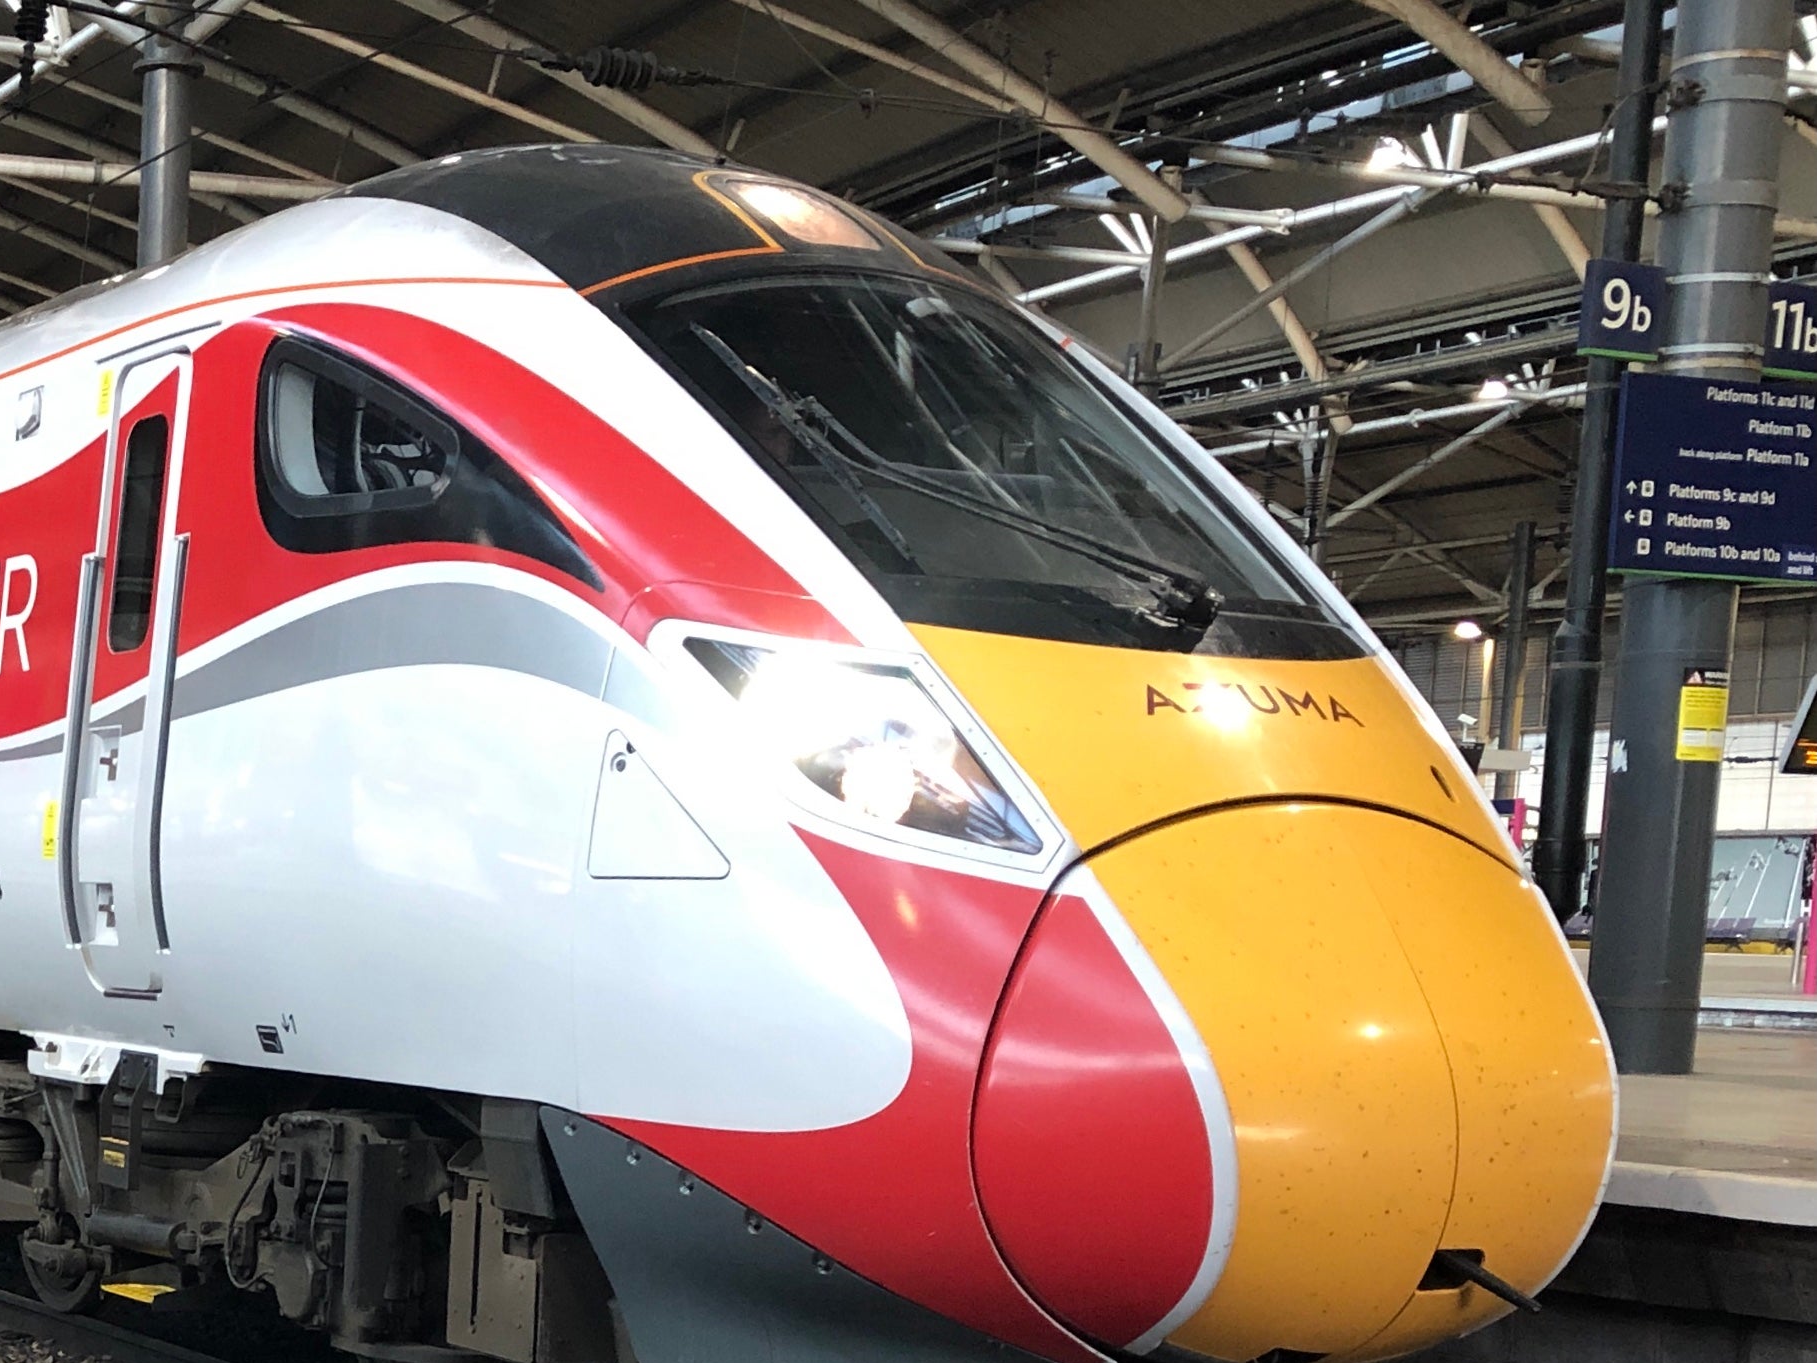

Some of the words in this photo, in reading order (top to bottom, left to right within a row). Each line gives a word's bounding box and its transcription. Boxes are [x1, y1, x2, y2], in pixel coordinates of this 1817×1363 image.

[1601, 277, 1652, 333] 9b
[1772, 299, 1817, 354] 11b
[1706, 386, 1759, 405] Platforms
[1761, 391, 1776, 406] 11c
[1777, 395, 1798, 408] and
[1799, 395, 1816, 410] 11d
[1748, 419, 1794, 436] Platform
[1795, 423, 1812, 438] 11b
[1746, 448, 1792, 464] Platform
[1794, 452, 1810, 466] 11a
[1669, 483, 1720, 501] Platforms
[1722, 488, 1737, 502] 9c
[1738, 490, 1759, 504] and
[1760, 490, 1776, 505] 9d
[1666, 512, 1714, 529] Platform
[1715, 516, 1731, 530] 9b
[1664, 541, 1717, 559] Platforms
[1719, 545, 1739, 560] 10b
[1740, 547, 1760, 561] and
[1762, 548, 1781, 563] 10a
[1787, 551, 1815, 563] behind
[1787, 565, 1802, 575] and
